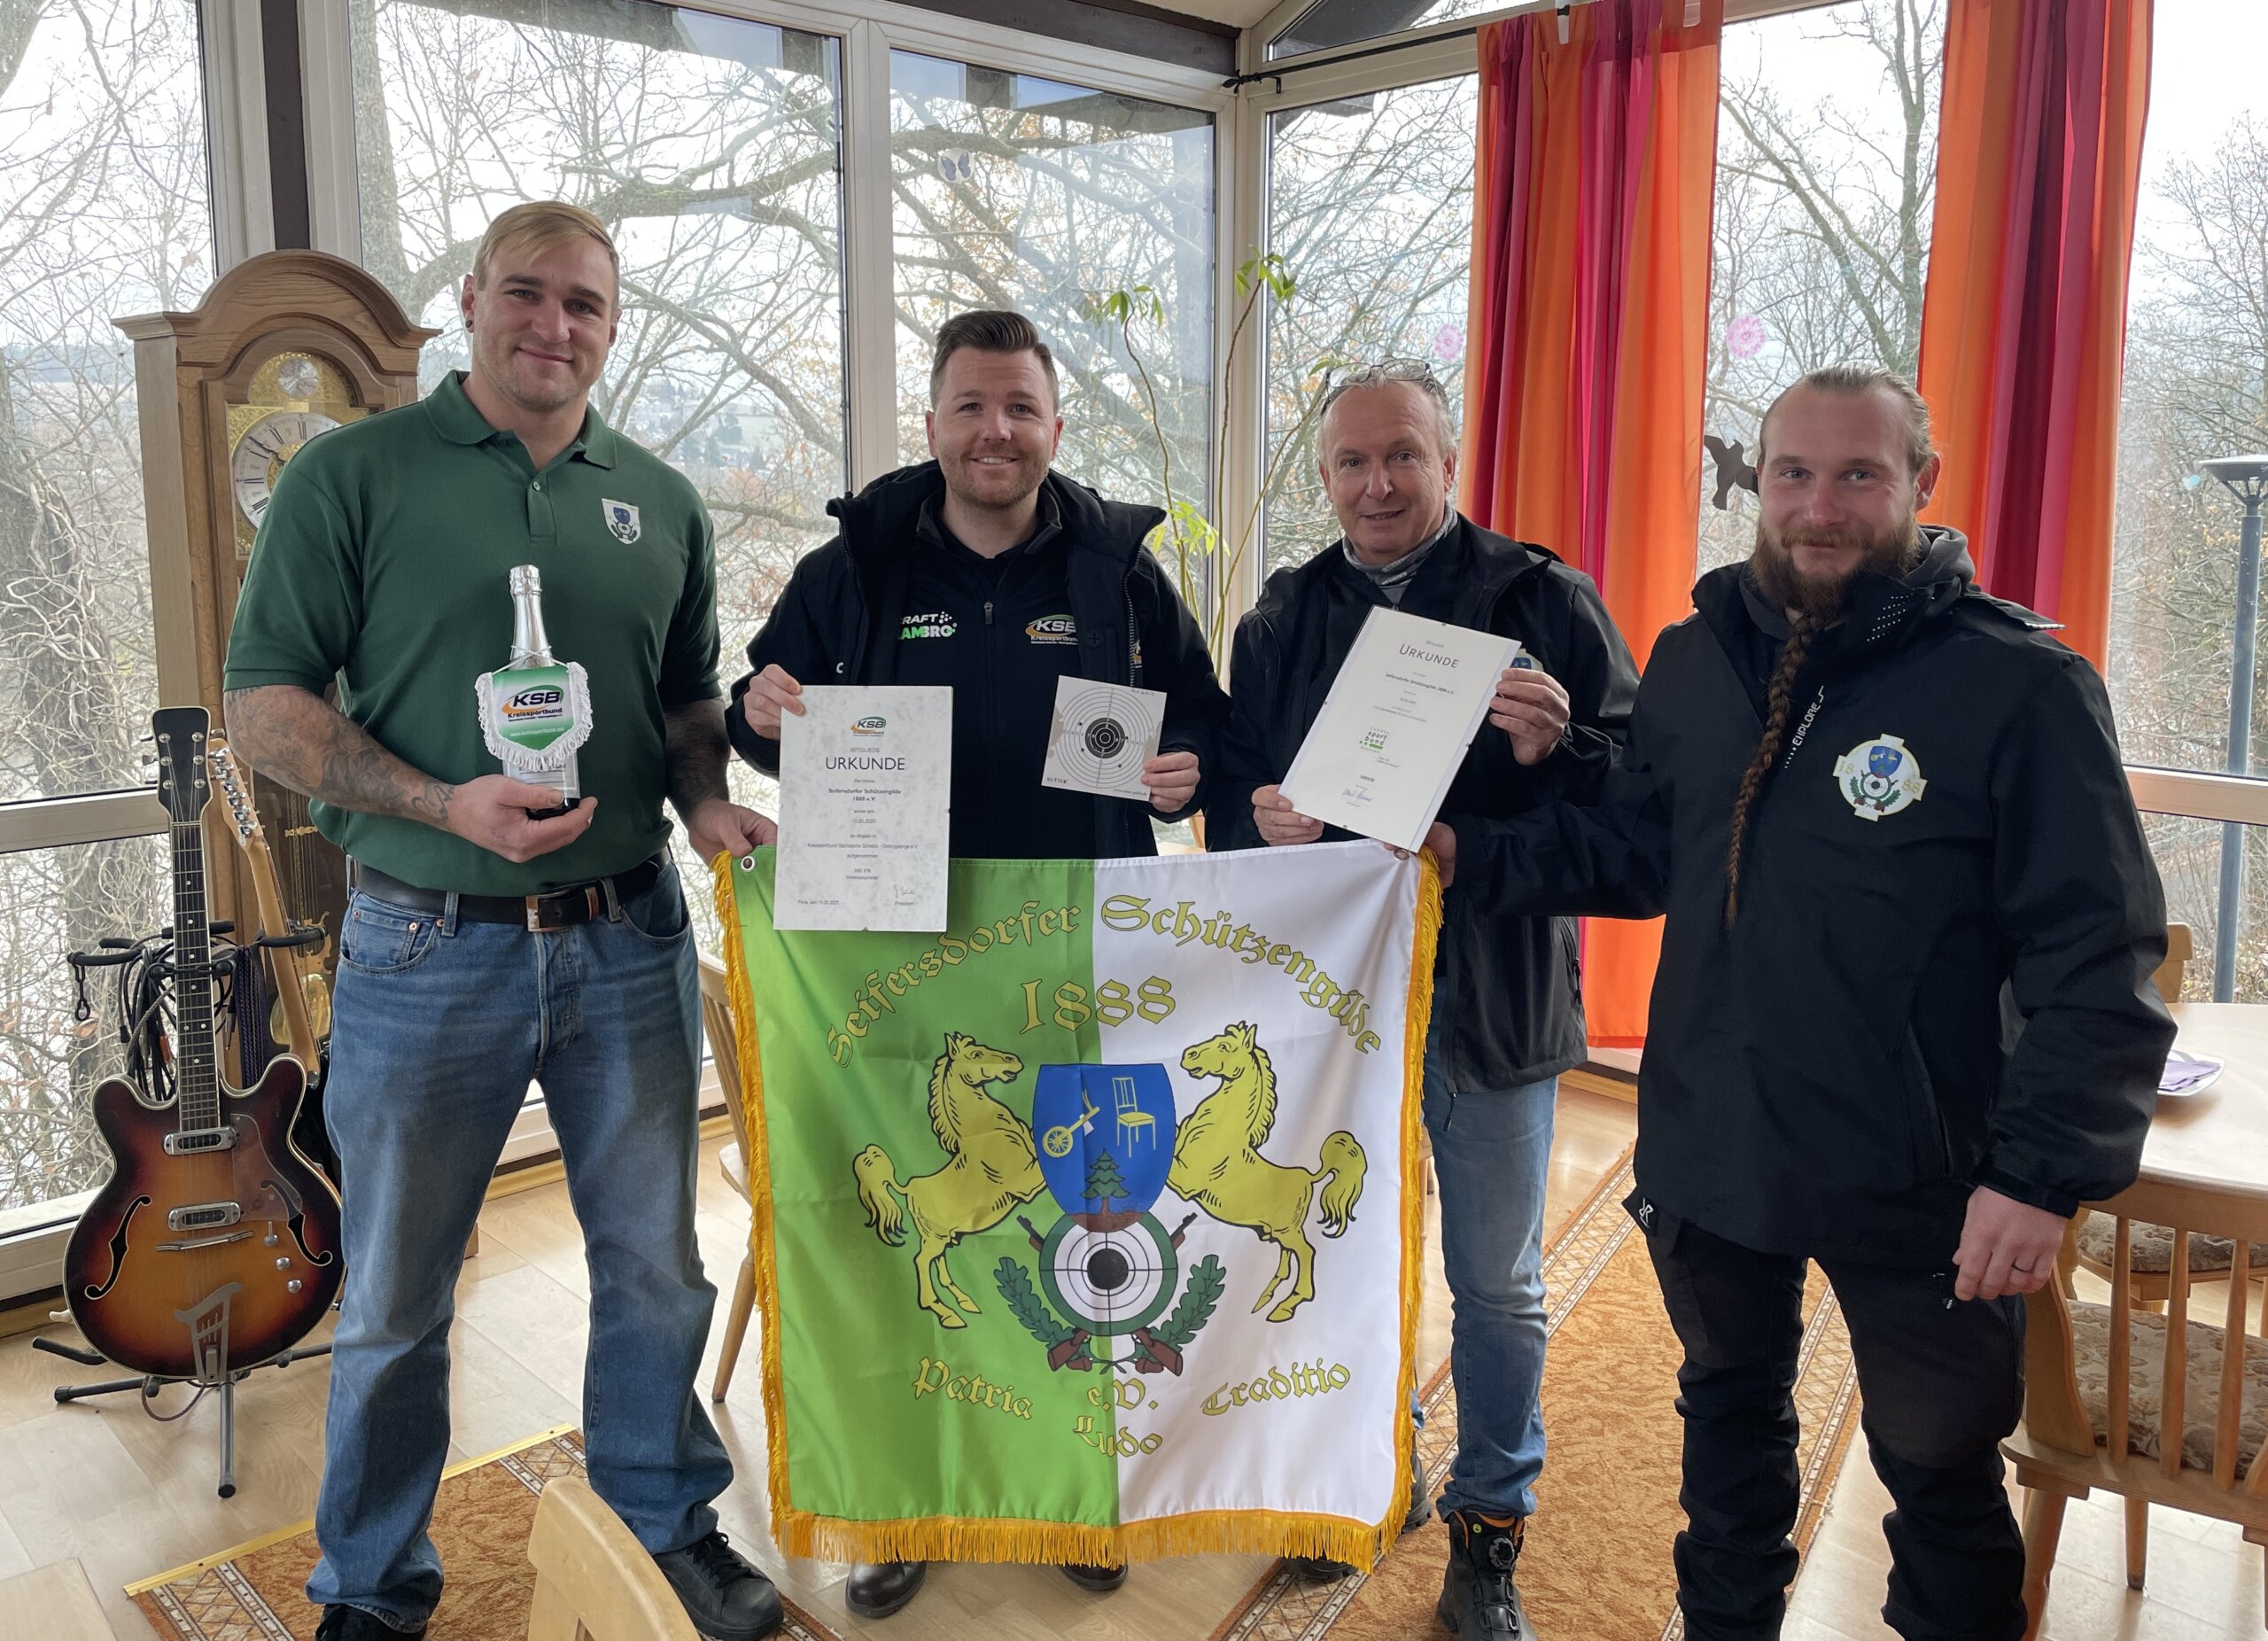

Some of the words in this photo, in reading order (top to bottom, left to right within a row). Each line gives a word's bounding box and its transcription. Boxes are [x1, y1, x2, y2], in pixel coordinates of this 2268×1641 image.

[900, 613, 939, 625] RAFT
[1399, 643, 1460, 669] URKUNDE
[513, 691, 560, 707] KSB
[508, 708, 563, 719] Kreissportbund
[1364, 735, 1385, 745] bund
[1368, 731, 1387, 740] sport
[826, 757, 905, 771] URKUNDE
[827, 899, 1081, 1068] Seifersdorfer
[1100, 894, 1381, 1054] Schützengilde
[1019, 976, 1177, 1035] 1888
[912, 1356, 1034, 1420] Patria
[1200, 1357, 1351, 1417] Traditio
[1072, 1415, 1163, 1458] Ludo
